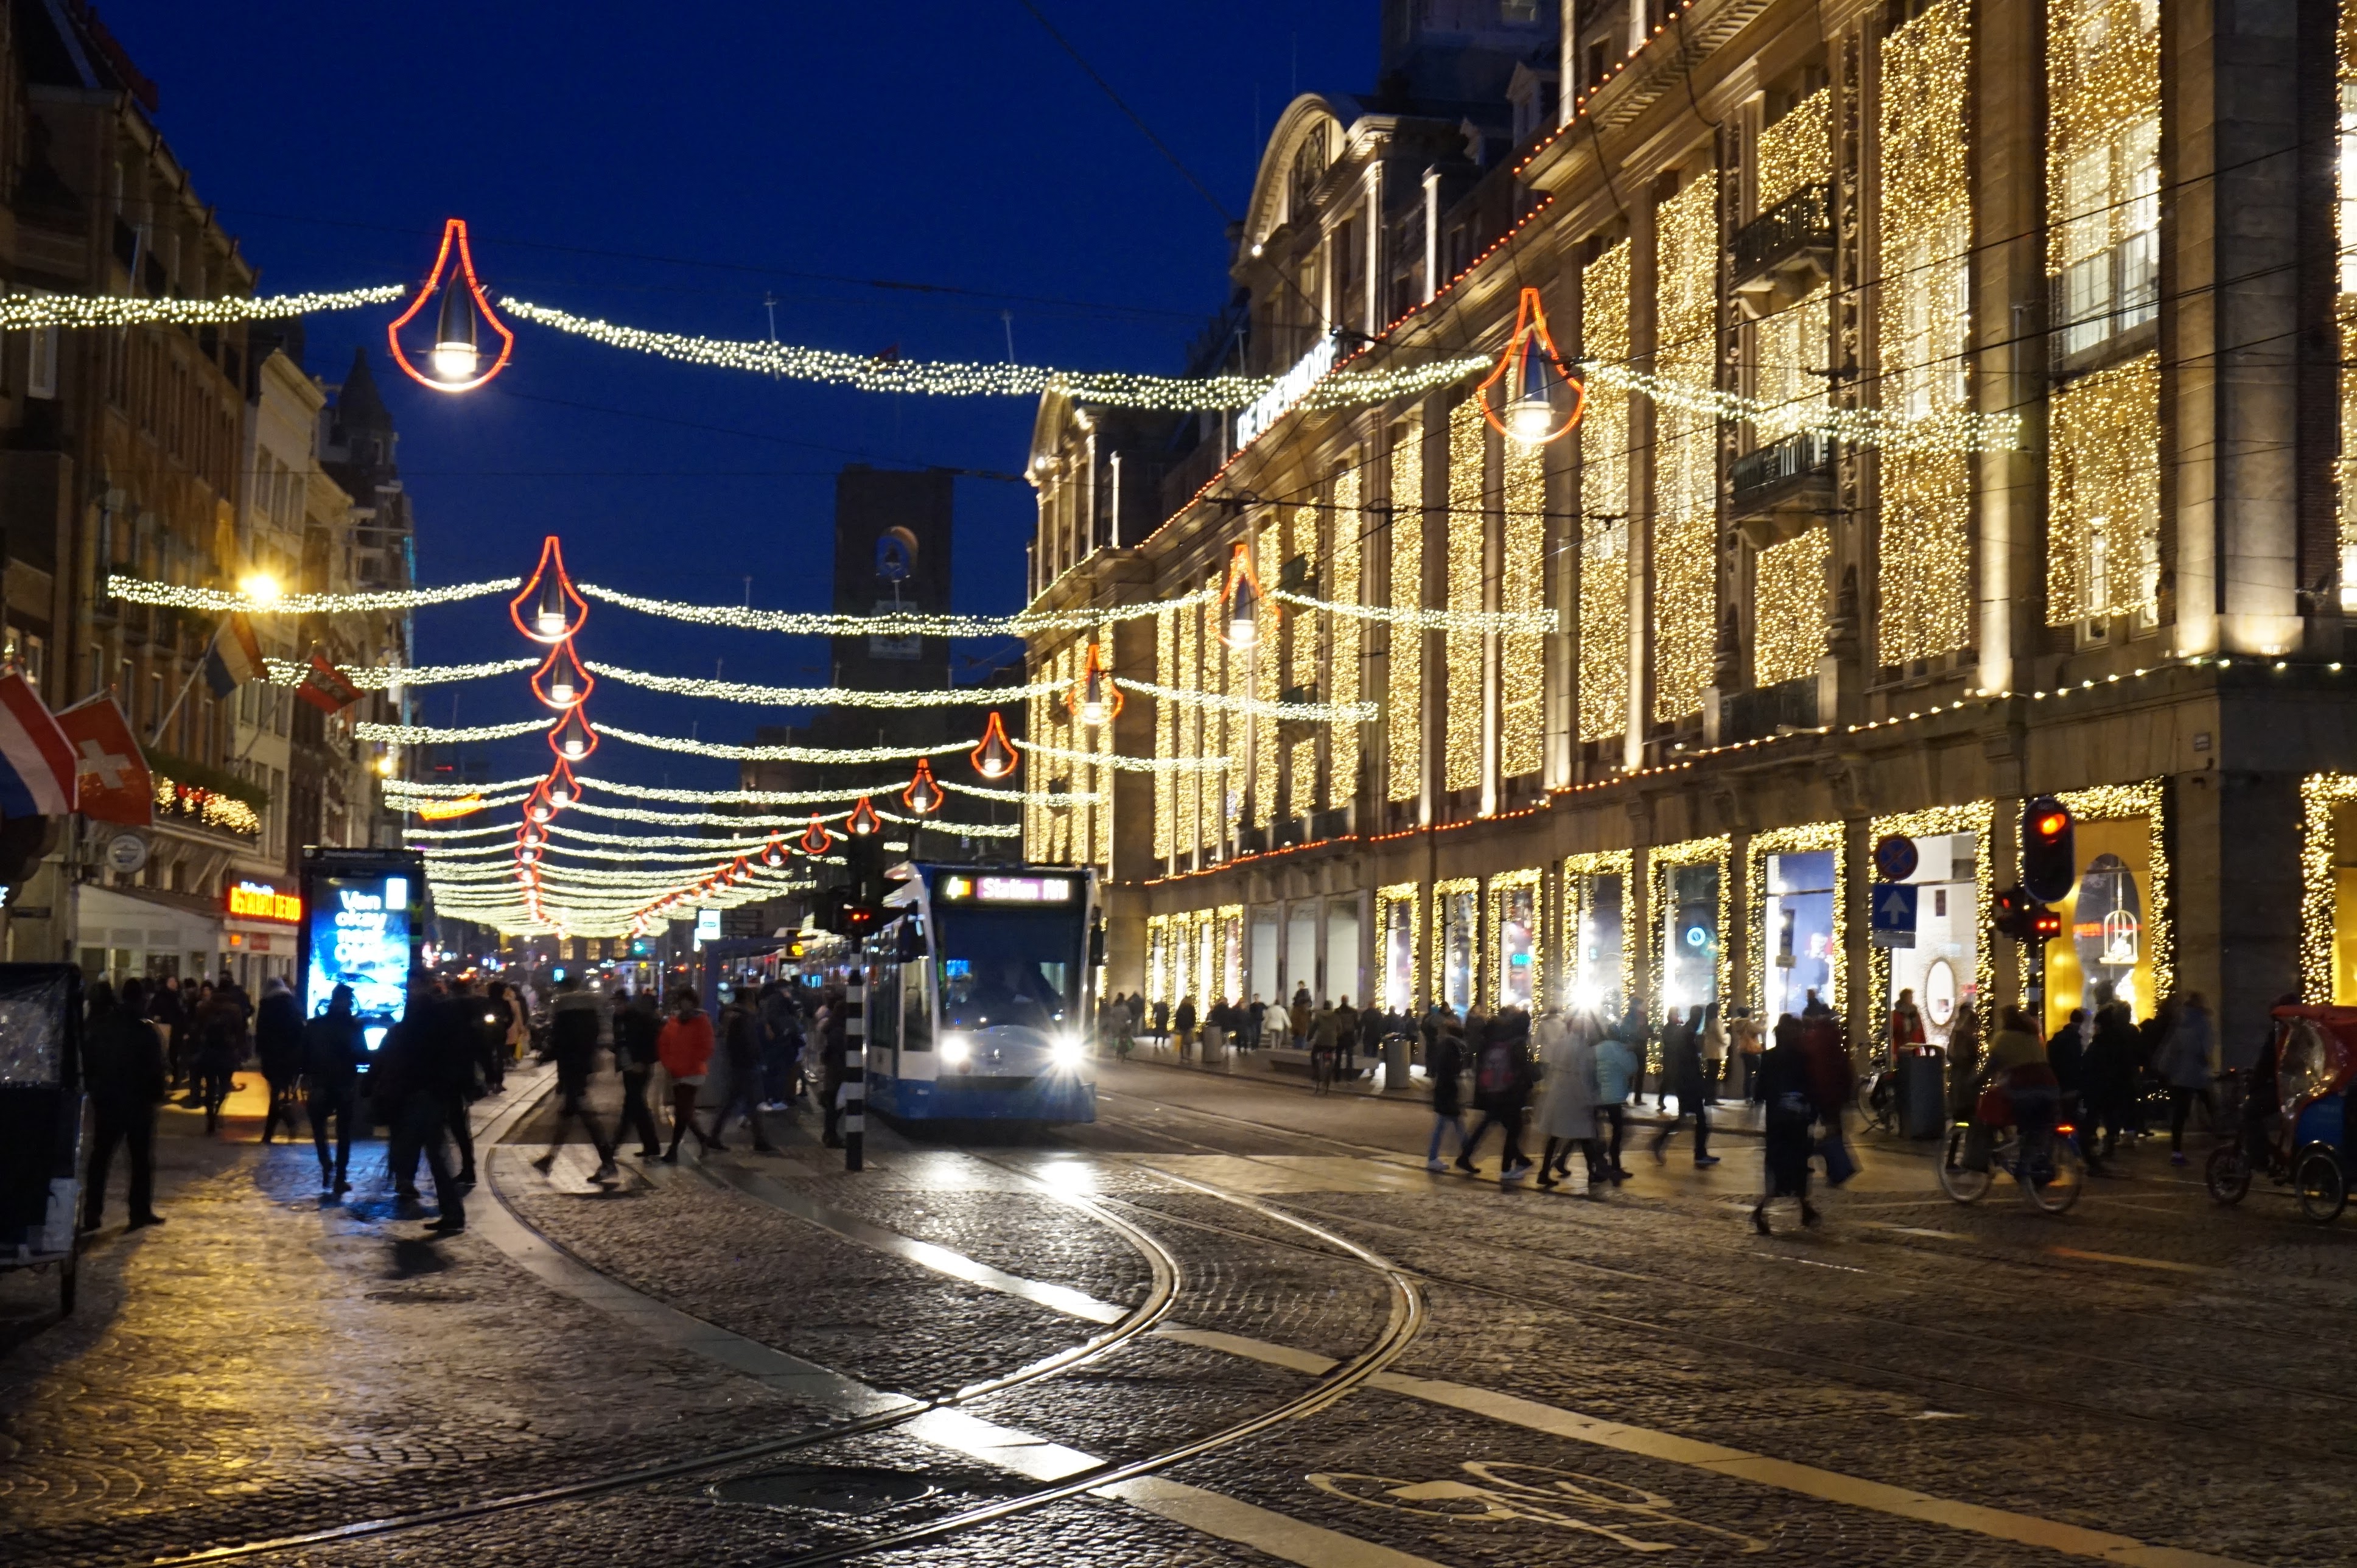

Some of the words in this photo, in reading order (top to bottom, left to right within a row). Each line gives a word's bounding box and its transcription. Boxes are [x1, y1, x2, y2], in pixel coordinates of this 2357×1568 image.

[946, 877, 962, 899] 4
[982, 878, 1038, 898] Station
[1043, 880, 1068, 899] RAI
[340, 891, 381, 909] Van
[335, 908, 388, 932] okay
